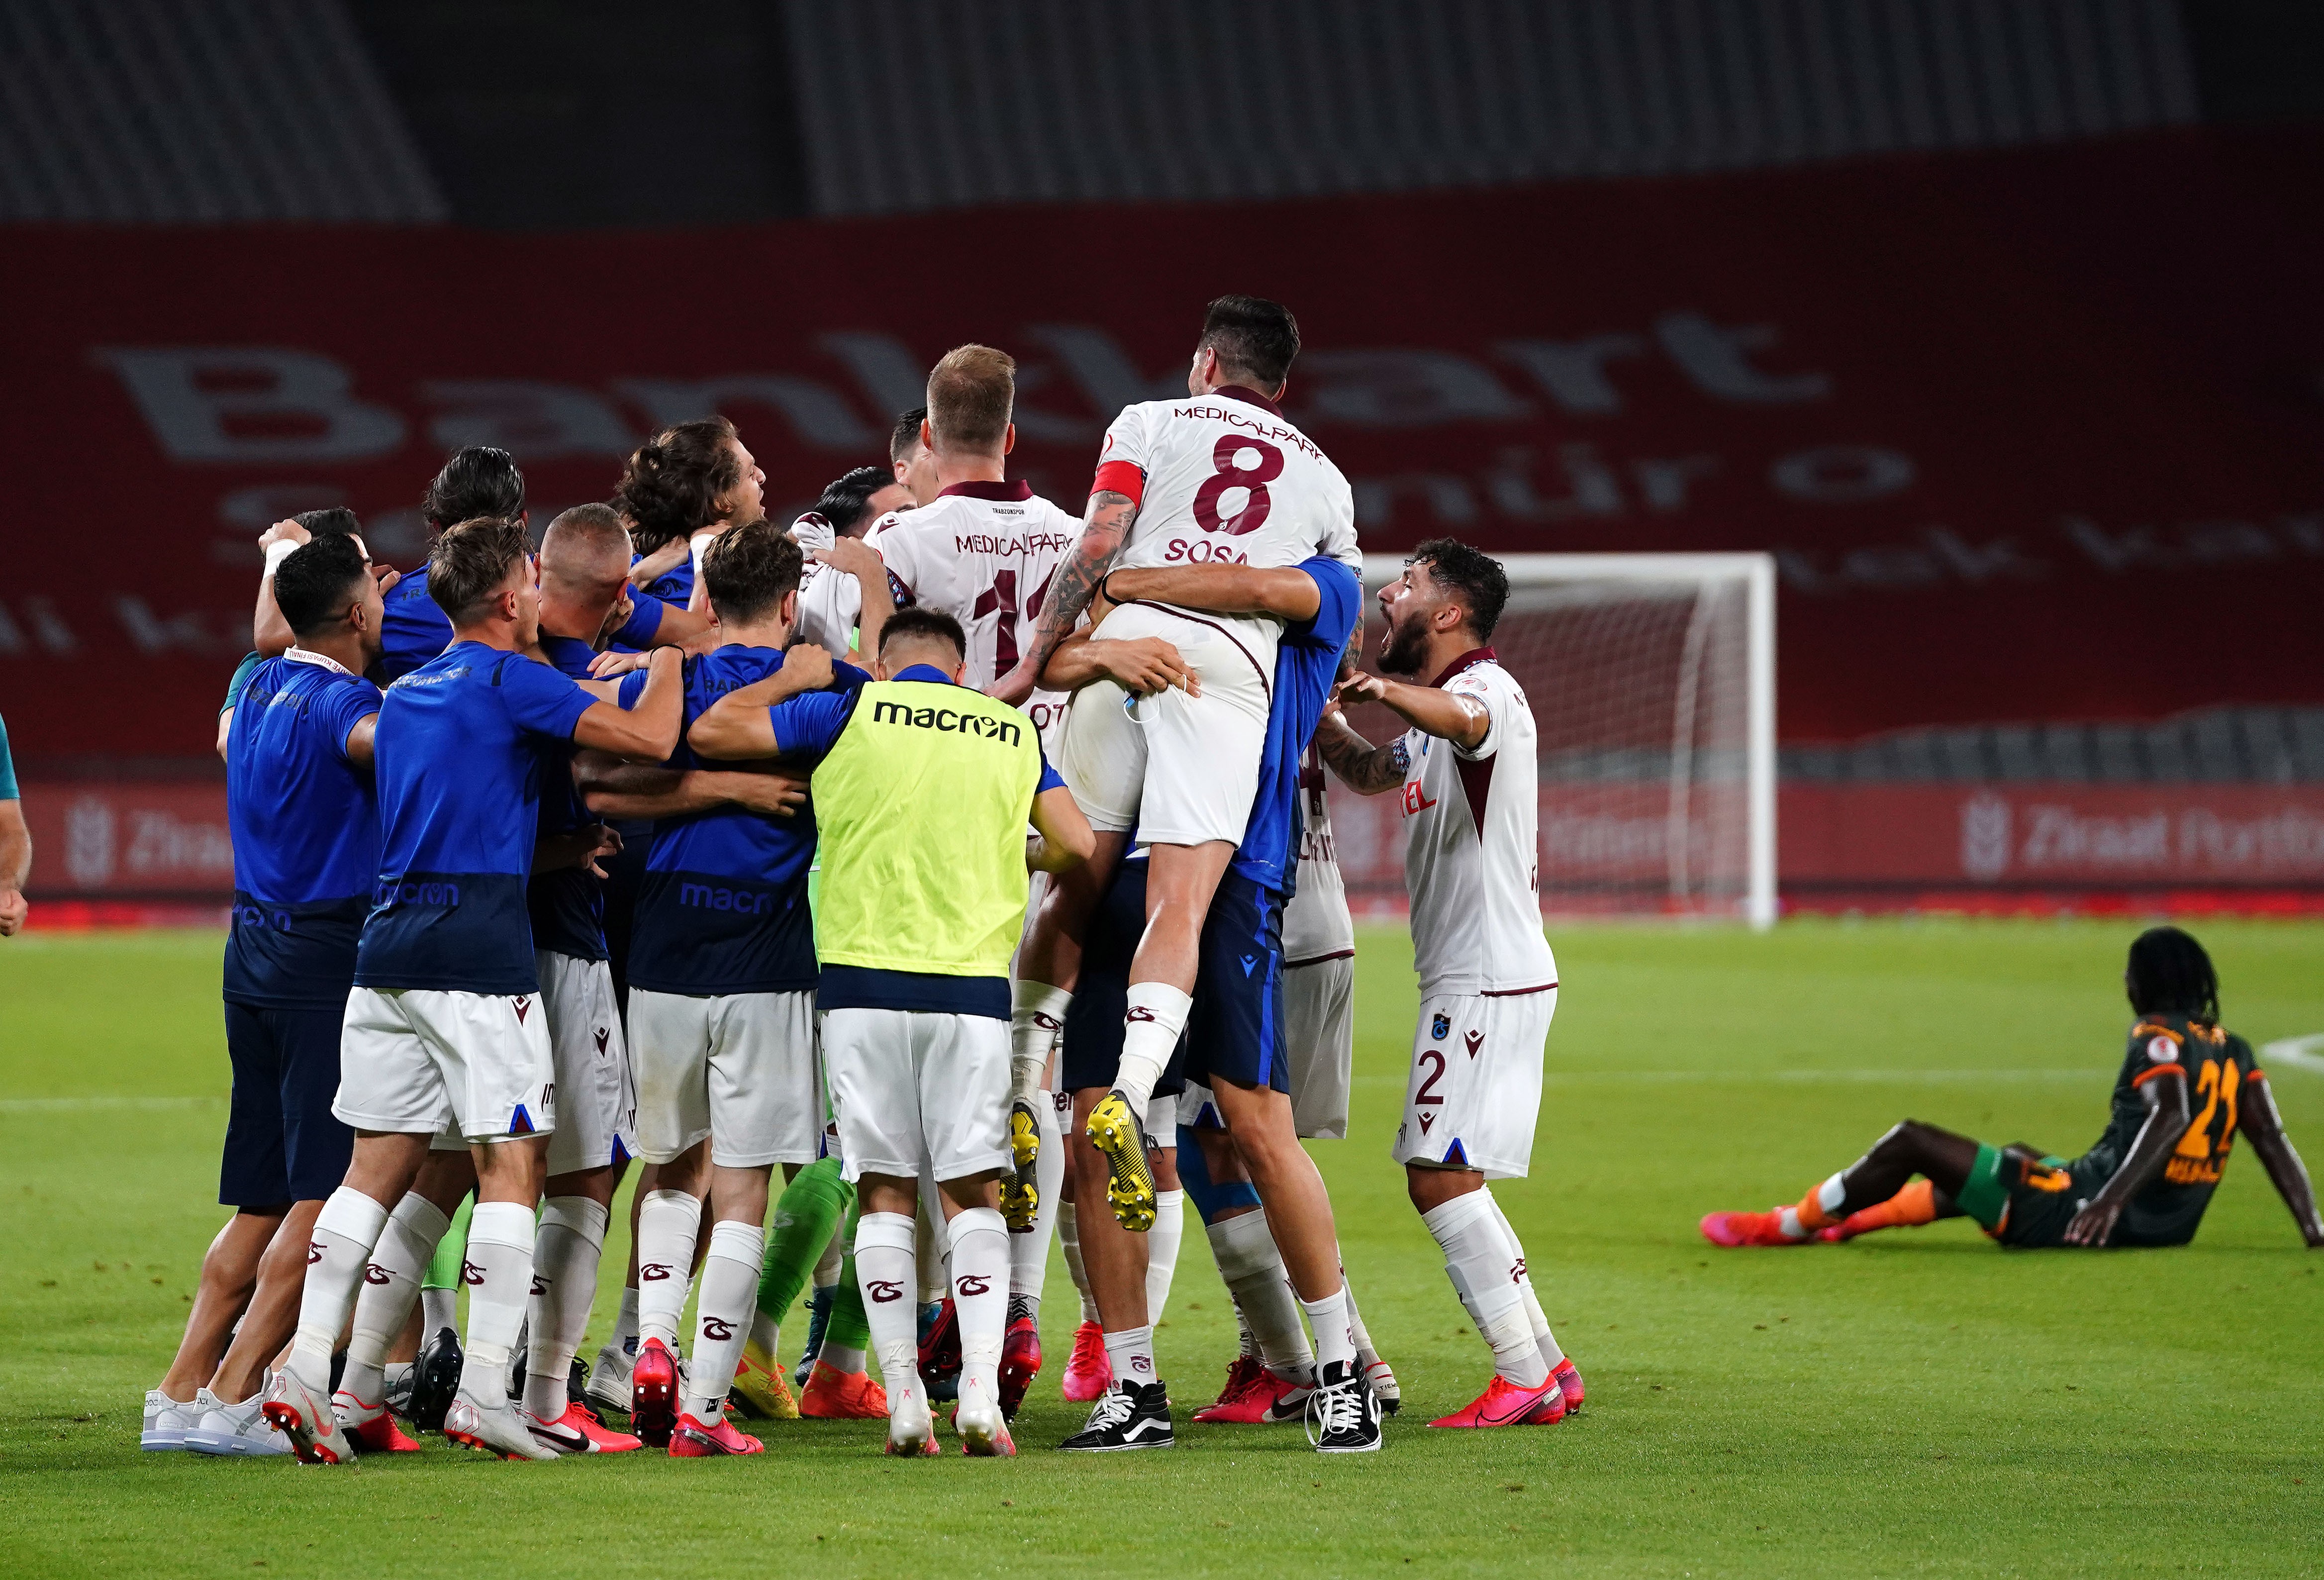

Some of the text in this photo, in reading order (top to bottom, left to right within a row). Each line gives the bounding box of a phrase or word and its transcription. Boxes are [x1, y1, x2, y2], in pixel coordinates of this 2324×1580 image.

[1192, 434, 1284, 536] 8
[873, 701, 1021, 748] macron
[1414, 1049, 1446, 1105] 2
[2175, 1057, 2240, 1159] 21
